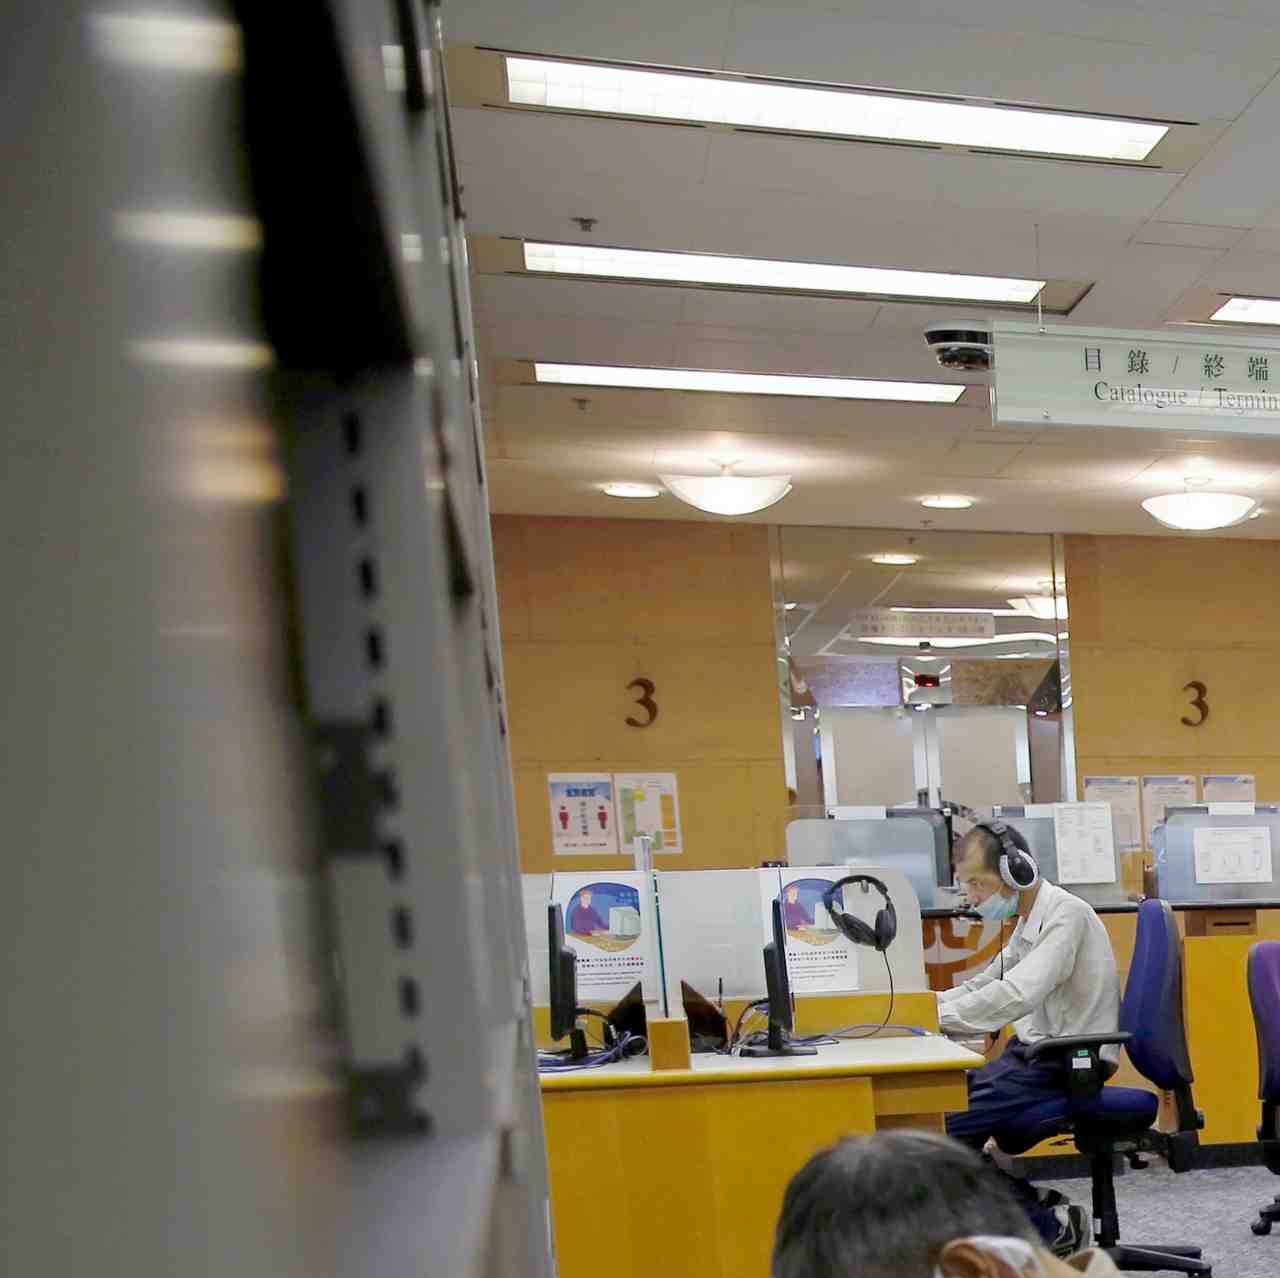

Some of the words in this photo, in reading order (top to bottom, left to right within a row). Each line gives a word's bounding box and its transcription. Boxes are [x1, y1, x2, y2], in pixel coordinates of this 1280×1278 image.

[1084, 347, 1149, 374] 目錄
[1094, 380, 1188, 408] Catalogue
[625, 677, 659, 728] 3
[1180, 680, 1210, 727] 3
